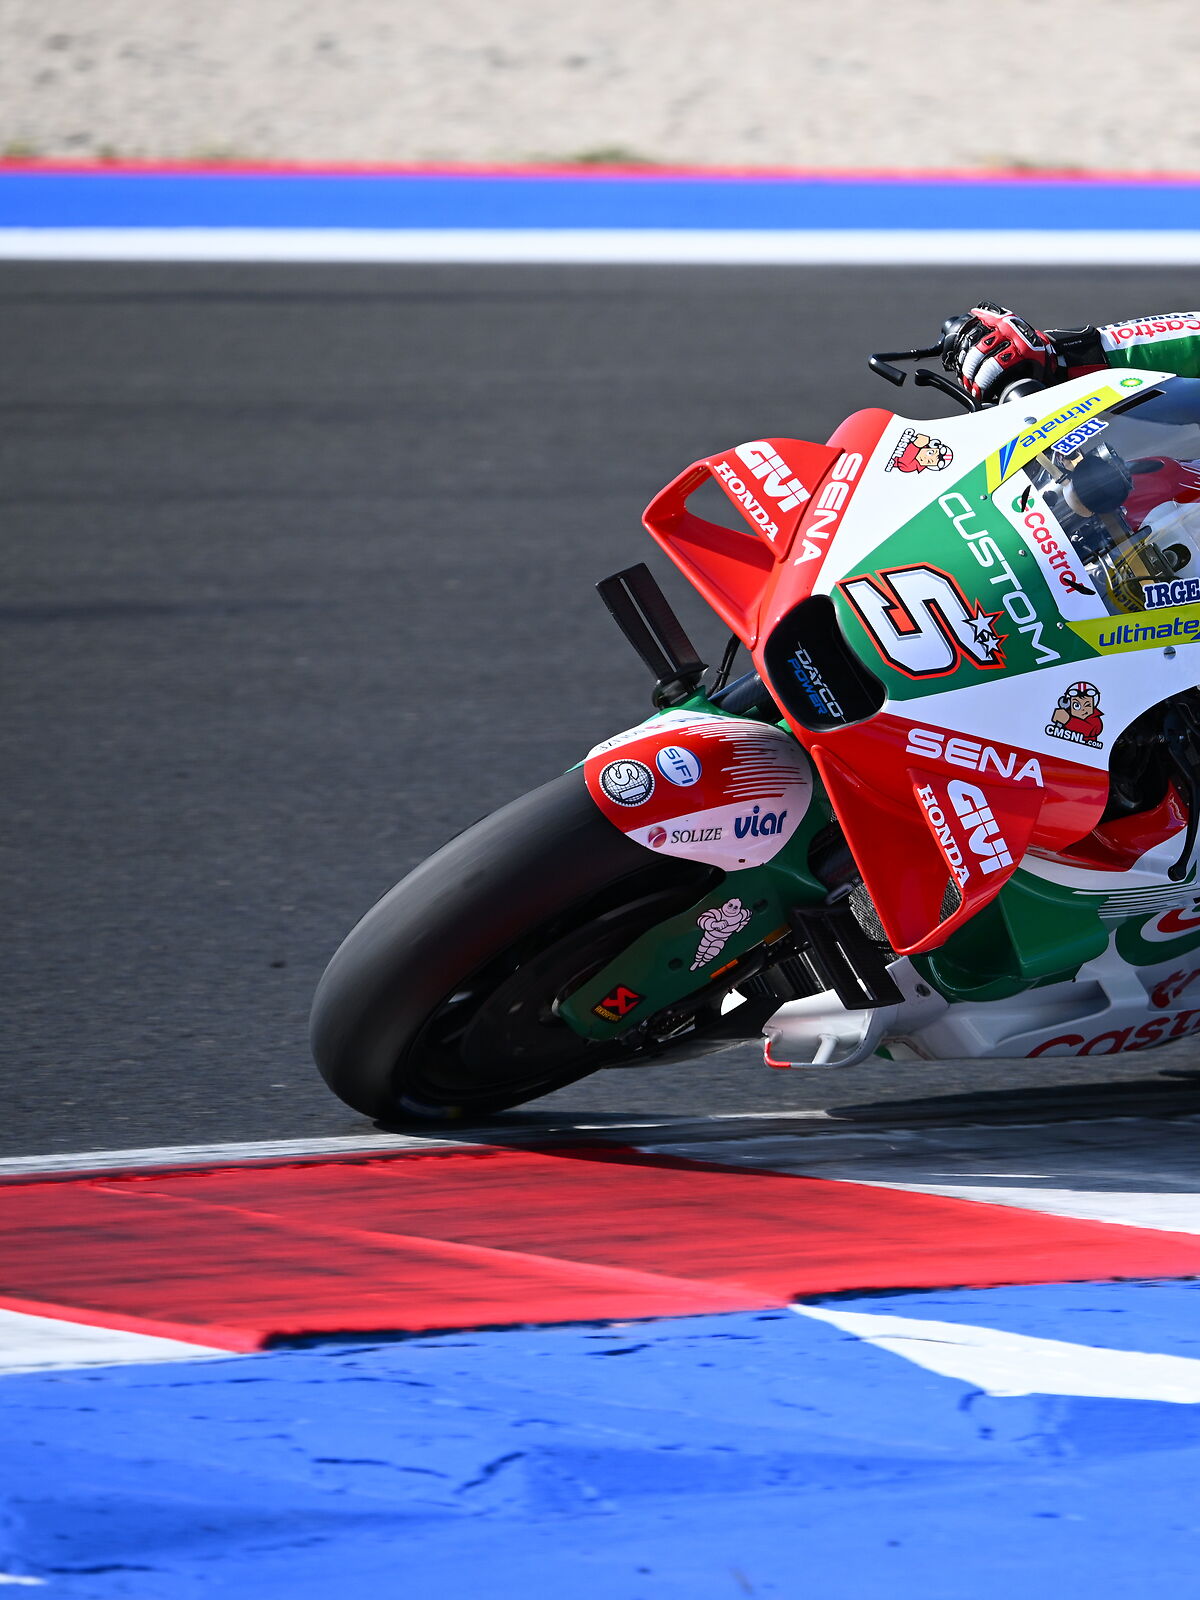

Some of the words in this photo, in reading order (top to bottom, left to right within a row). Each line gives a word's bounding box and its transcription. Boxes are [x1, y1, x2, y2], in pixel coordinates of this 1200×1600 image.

[1020, 396, 1101, 448] ultimate
[1052, 418, 1107, 454] IRGE
[714, 460, 779, 542] HONDA
[735, 441, 811, 513] GIVI
[794, 452, 863, 566] SENA
[938, 492, 1061, 665] CUSTOM
[1143, 578, 1200, 608] IRGE
[836, 562, 1008, 680] 5
[1099, 616, 1200, 647] ultimate
[787, 658, 829, 714] POWER
[794, 649, 844, 718] DAYCO
[663, 747, 695, 785] SIFI
[906, 727, 1045, 788] SENA
[671, 827, 723, 844] SOLIZE
[734, 805, 788, 840] viar
[917, 783, 971, 889] HONDA
[947, 779, 1014, 875] GIVI
